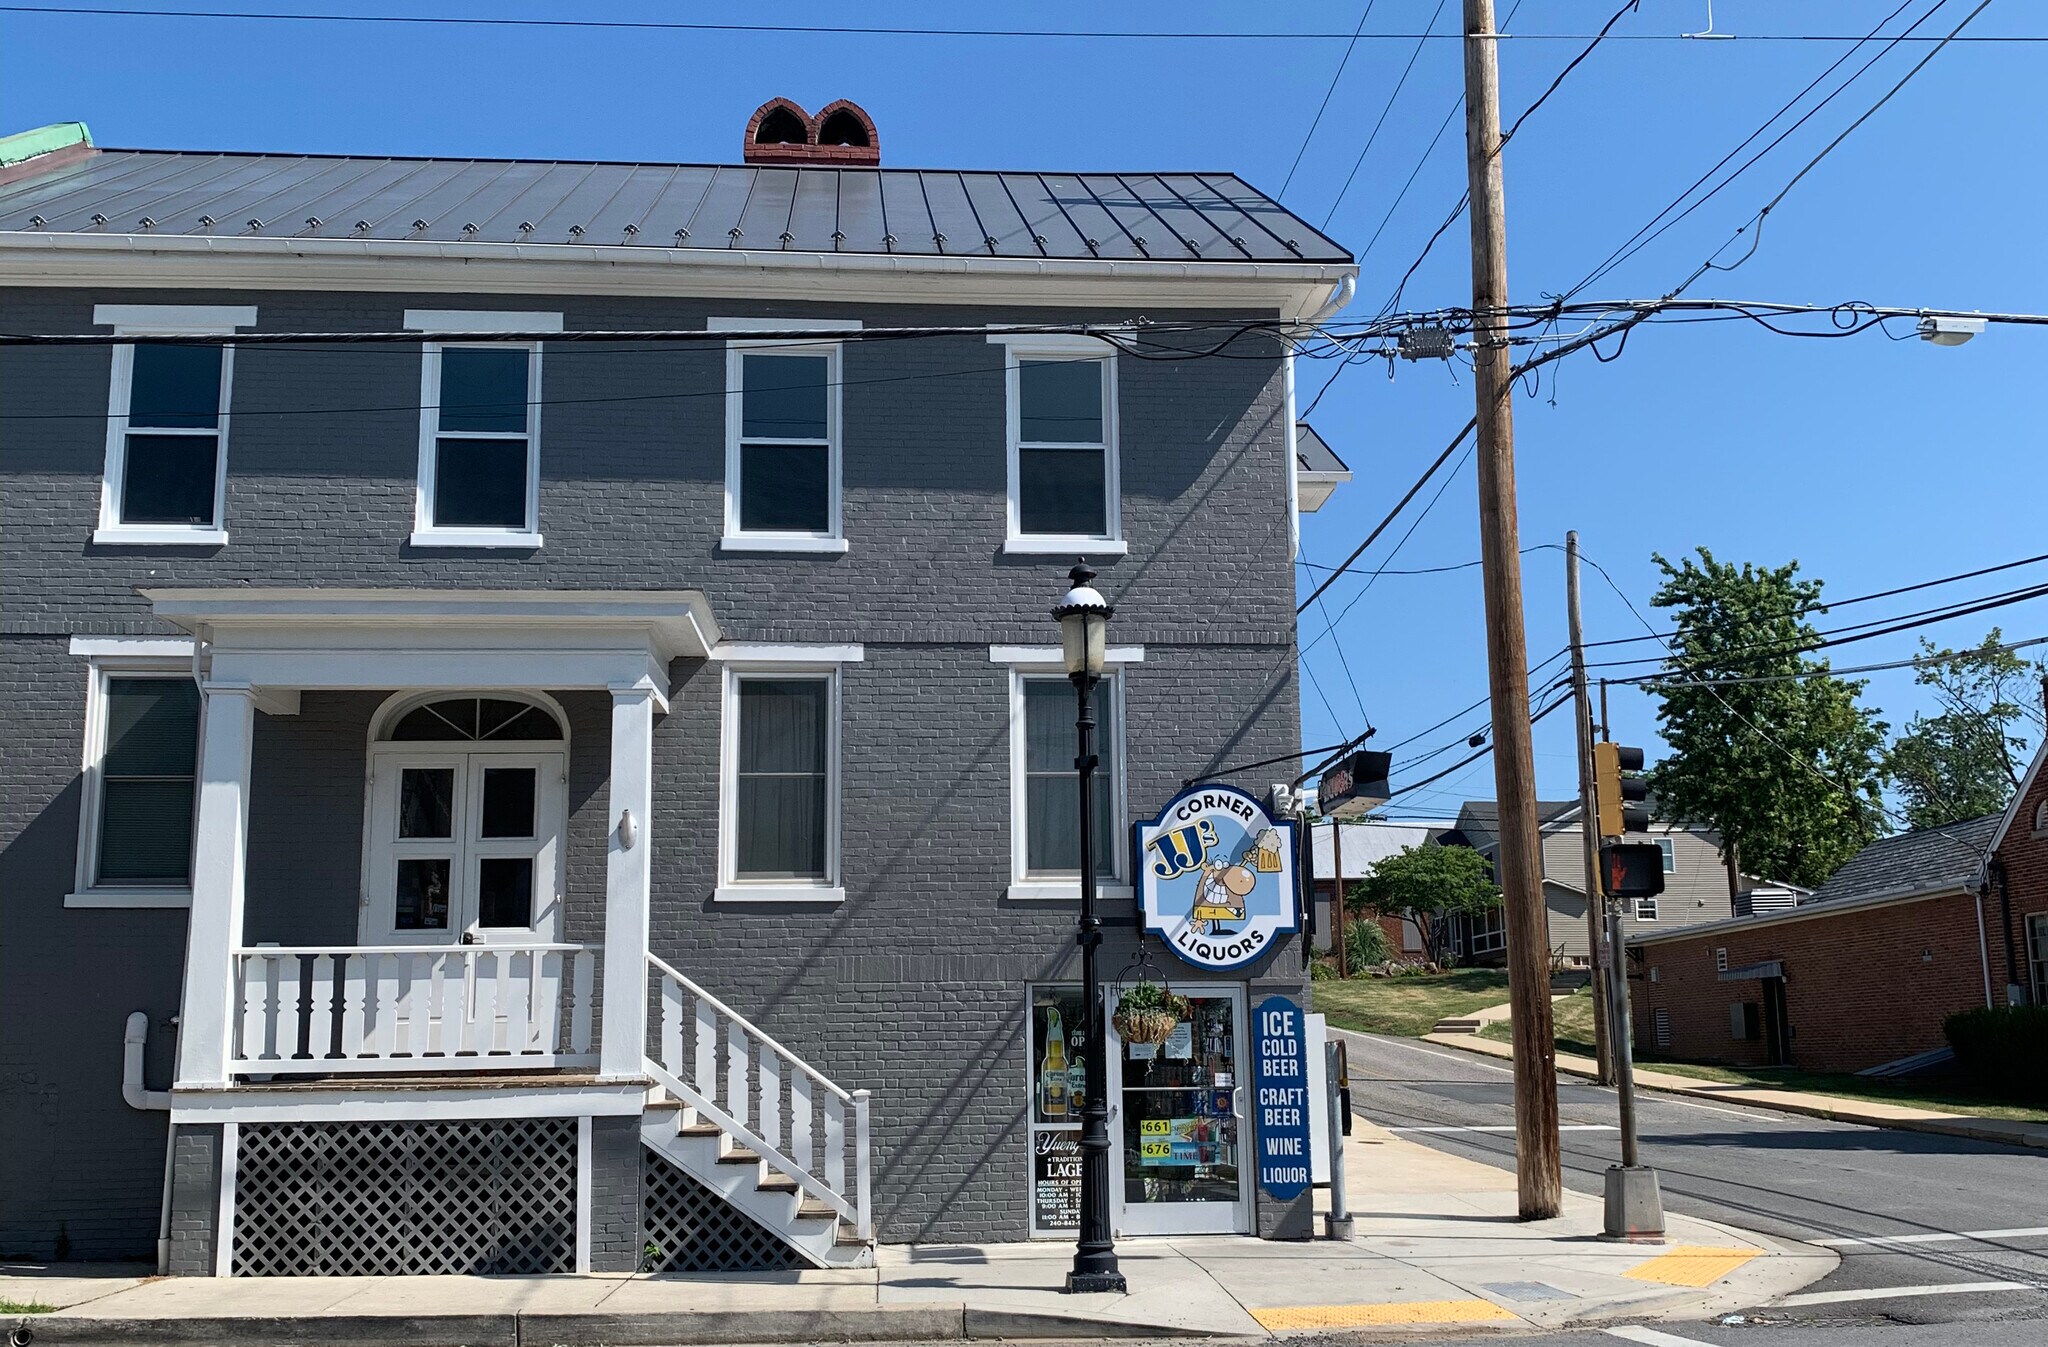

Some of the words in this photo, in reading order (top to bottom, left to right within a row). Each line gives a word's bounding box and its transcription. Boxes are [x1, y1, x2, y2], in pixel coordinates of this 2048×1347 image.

[1176, 794, 1254, 821] CORNER
[1177, 930, 1265, 961] LIQUORS
[1262, 1011, 1295, 1037] ICE
[1071, 1036, 1086, 1047] OP
[1262, 1039, 1297, 1057] COLD
[1263, 1059, 1299, 1077] BEER
[1259, 1088, 1303, 1106] CRAFT
[1264, 1108, 1301, 1126] BEER
[1036, 1132, 1080, 1155] Yueng
[1266, 1138, 1303, 1156] WINE
[1047, 1163, 1082, 1177] LAGE
[1263, 1167, 1307, 1184] LIQUOR
